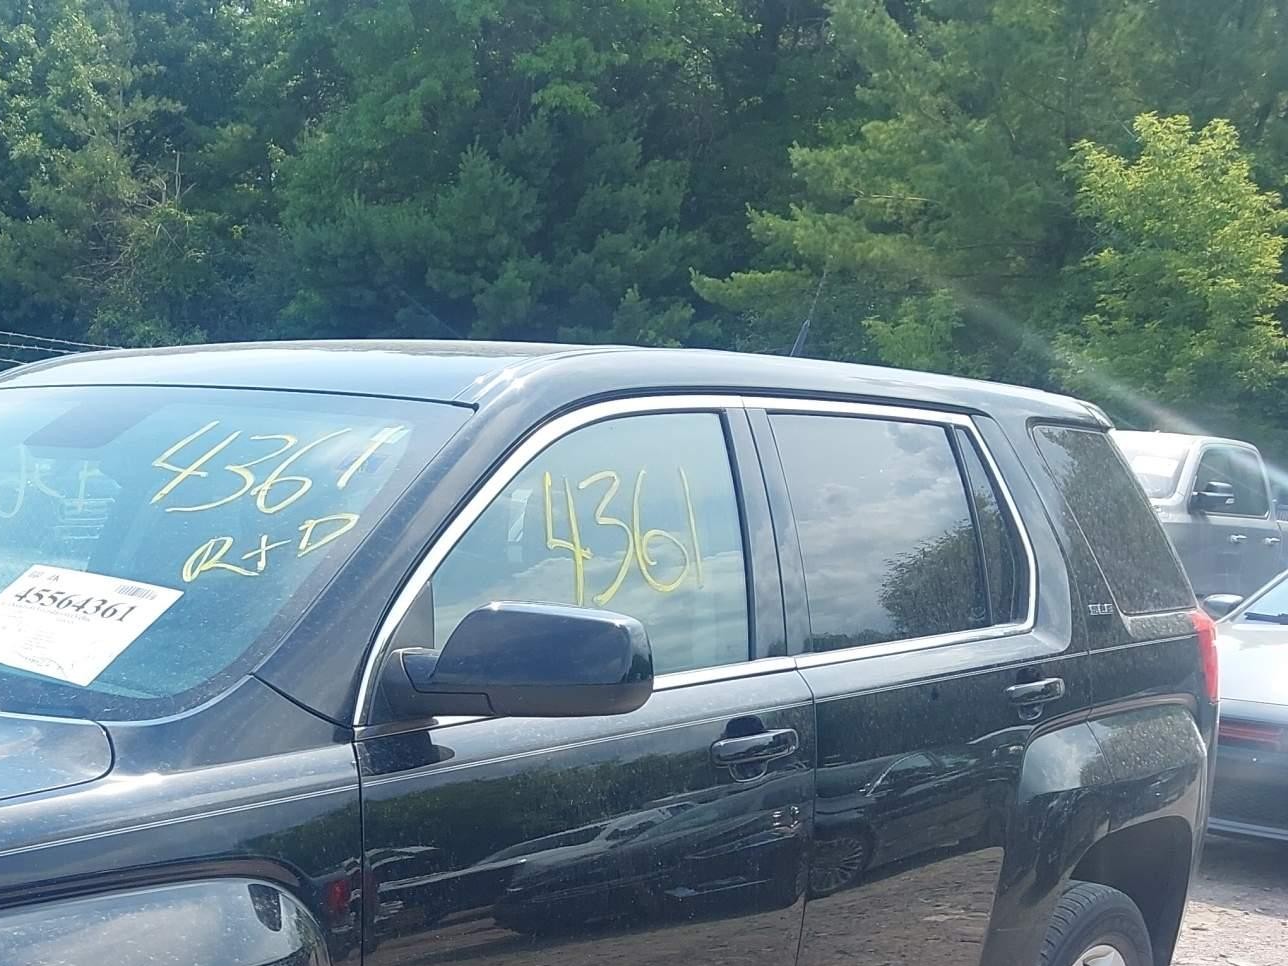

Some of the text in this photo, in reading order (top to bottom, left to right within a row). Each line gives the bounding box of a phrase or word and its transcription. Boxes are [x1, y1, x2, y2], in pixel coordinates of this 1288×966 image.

[149, 419, 406, 514] 4361
[543, 466, 704, 608] 4361
[15, 586, 137, 623] 45564361
